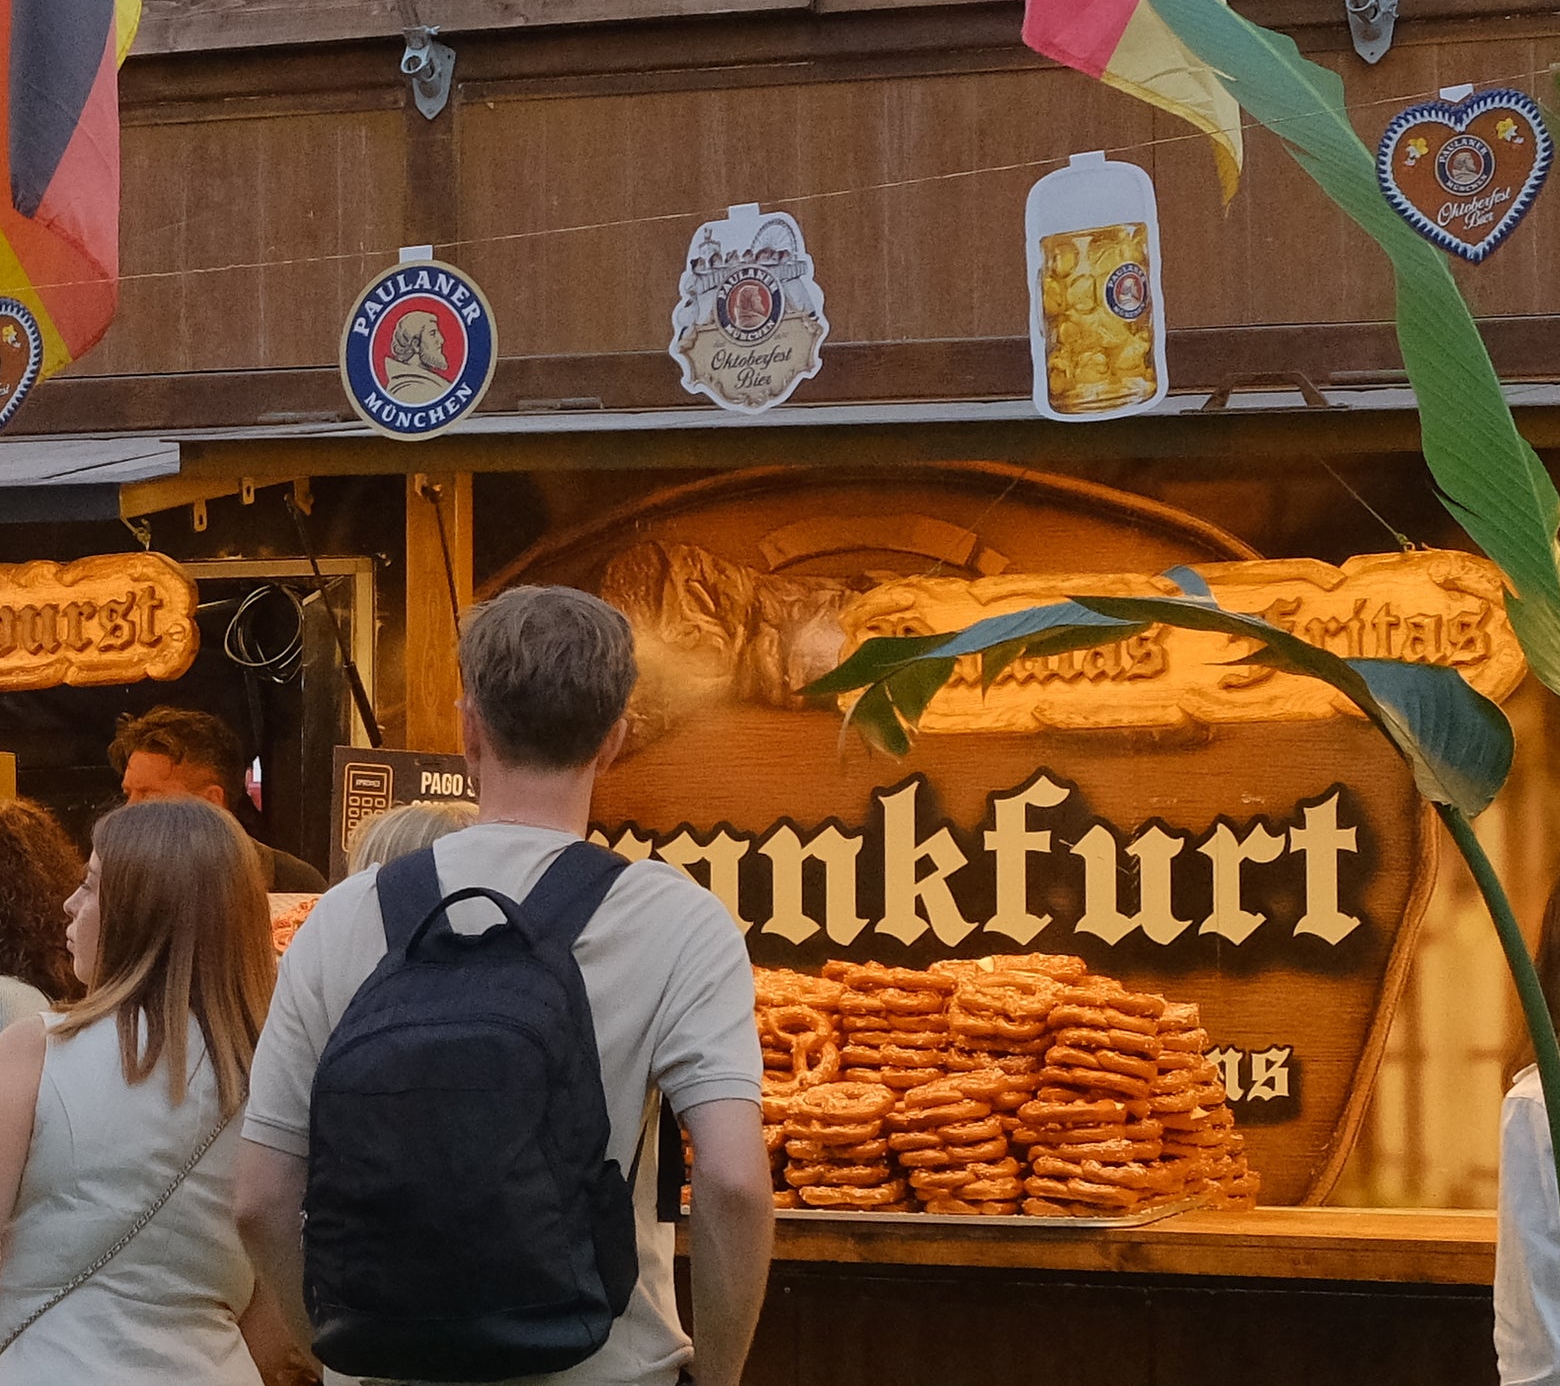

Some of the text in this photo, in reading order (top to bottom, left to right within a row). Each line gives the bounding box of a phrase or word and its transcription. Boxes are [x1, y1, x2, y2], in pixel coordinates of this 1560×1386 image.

[1437, 186, 1511, 226] Oktoberfest
[1463, 209, 1494, 230] Bier
[718, 268, 778, 299] PAULANER
[352, 270, 482, 337] PAULANER
[711, 345, 792, 370] Oktoberfest
[734, 367, 772, 389] Bier
[364, 382, 473, 428] MÜNCHEN
[420, 771, 464, 797] PAGO
[591, 775, 1363, 947] ankfurt
